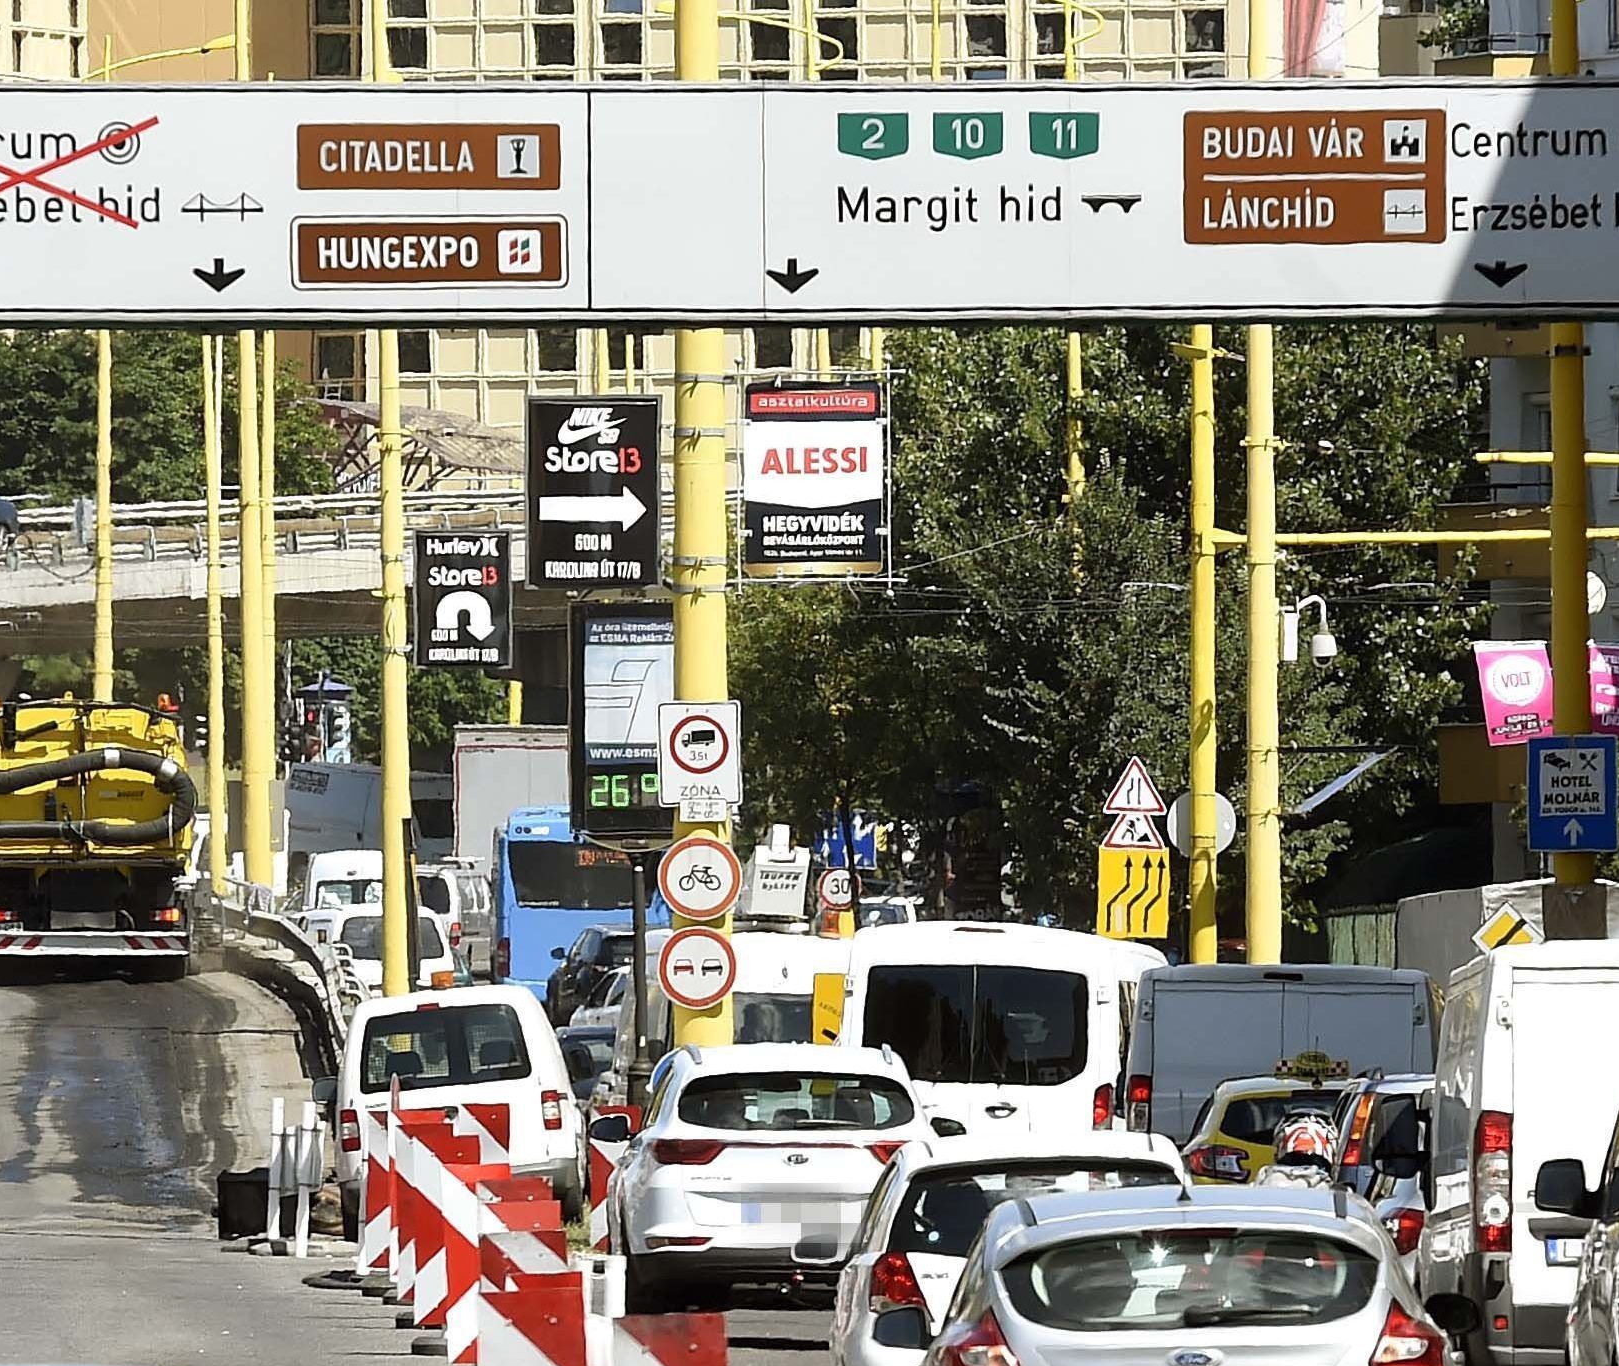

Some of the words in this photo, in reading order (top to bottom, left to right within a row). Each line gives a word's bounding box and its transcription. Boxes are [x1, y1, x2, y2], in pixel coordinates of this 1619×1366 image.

[861, 118, 885, 149] 2
[951, 118, 984, 150] 10
[1052, 118, 1077, 150] 11
[1203, 126, 1293, 159] BUDAI
[1308, 118, 1364, 158] VÁR
[1451, 122, 1607, 157] Centrum
[320, 141, 474, 172] CITADELLA
[837, 186, 978, 231] Margit
[1203, 187, 1335, 229] LÁNCHÍD
[1451, 193, 1601, 231] Erzsébet
[318, 236, 479, 269] HUNGEXPO
[758, 394, 868, 407] asztalkultúra
[569, 407, 613, 427] NIKE
[761, 447, 867, 474] ALESSI
[763, 512, 864, 533] HEGYVIDÉK
[426, 538, 481, 556] Hurley
[574, 533, 599, 551] 600
[1501, 671, 1530, 688] VOLT
[680, 782, 721, 797] ZÓNA
[1551, 775, 1592, 788] HOTEL
[1544, 788, 1600, 805] MOLNÁR
[830, 878, 851, 894] 30
